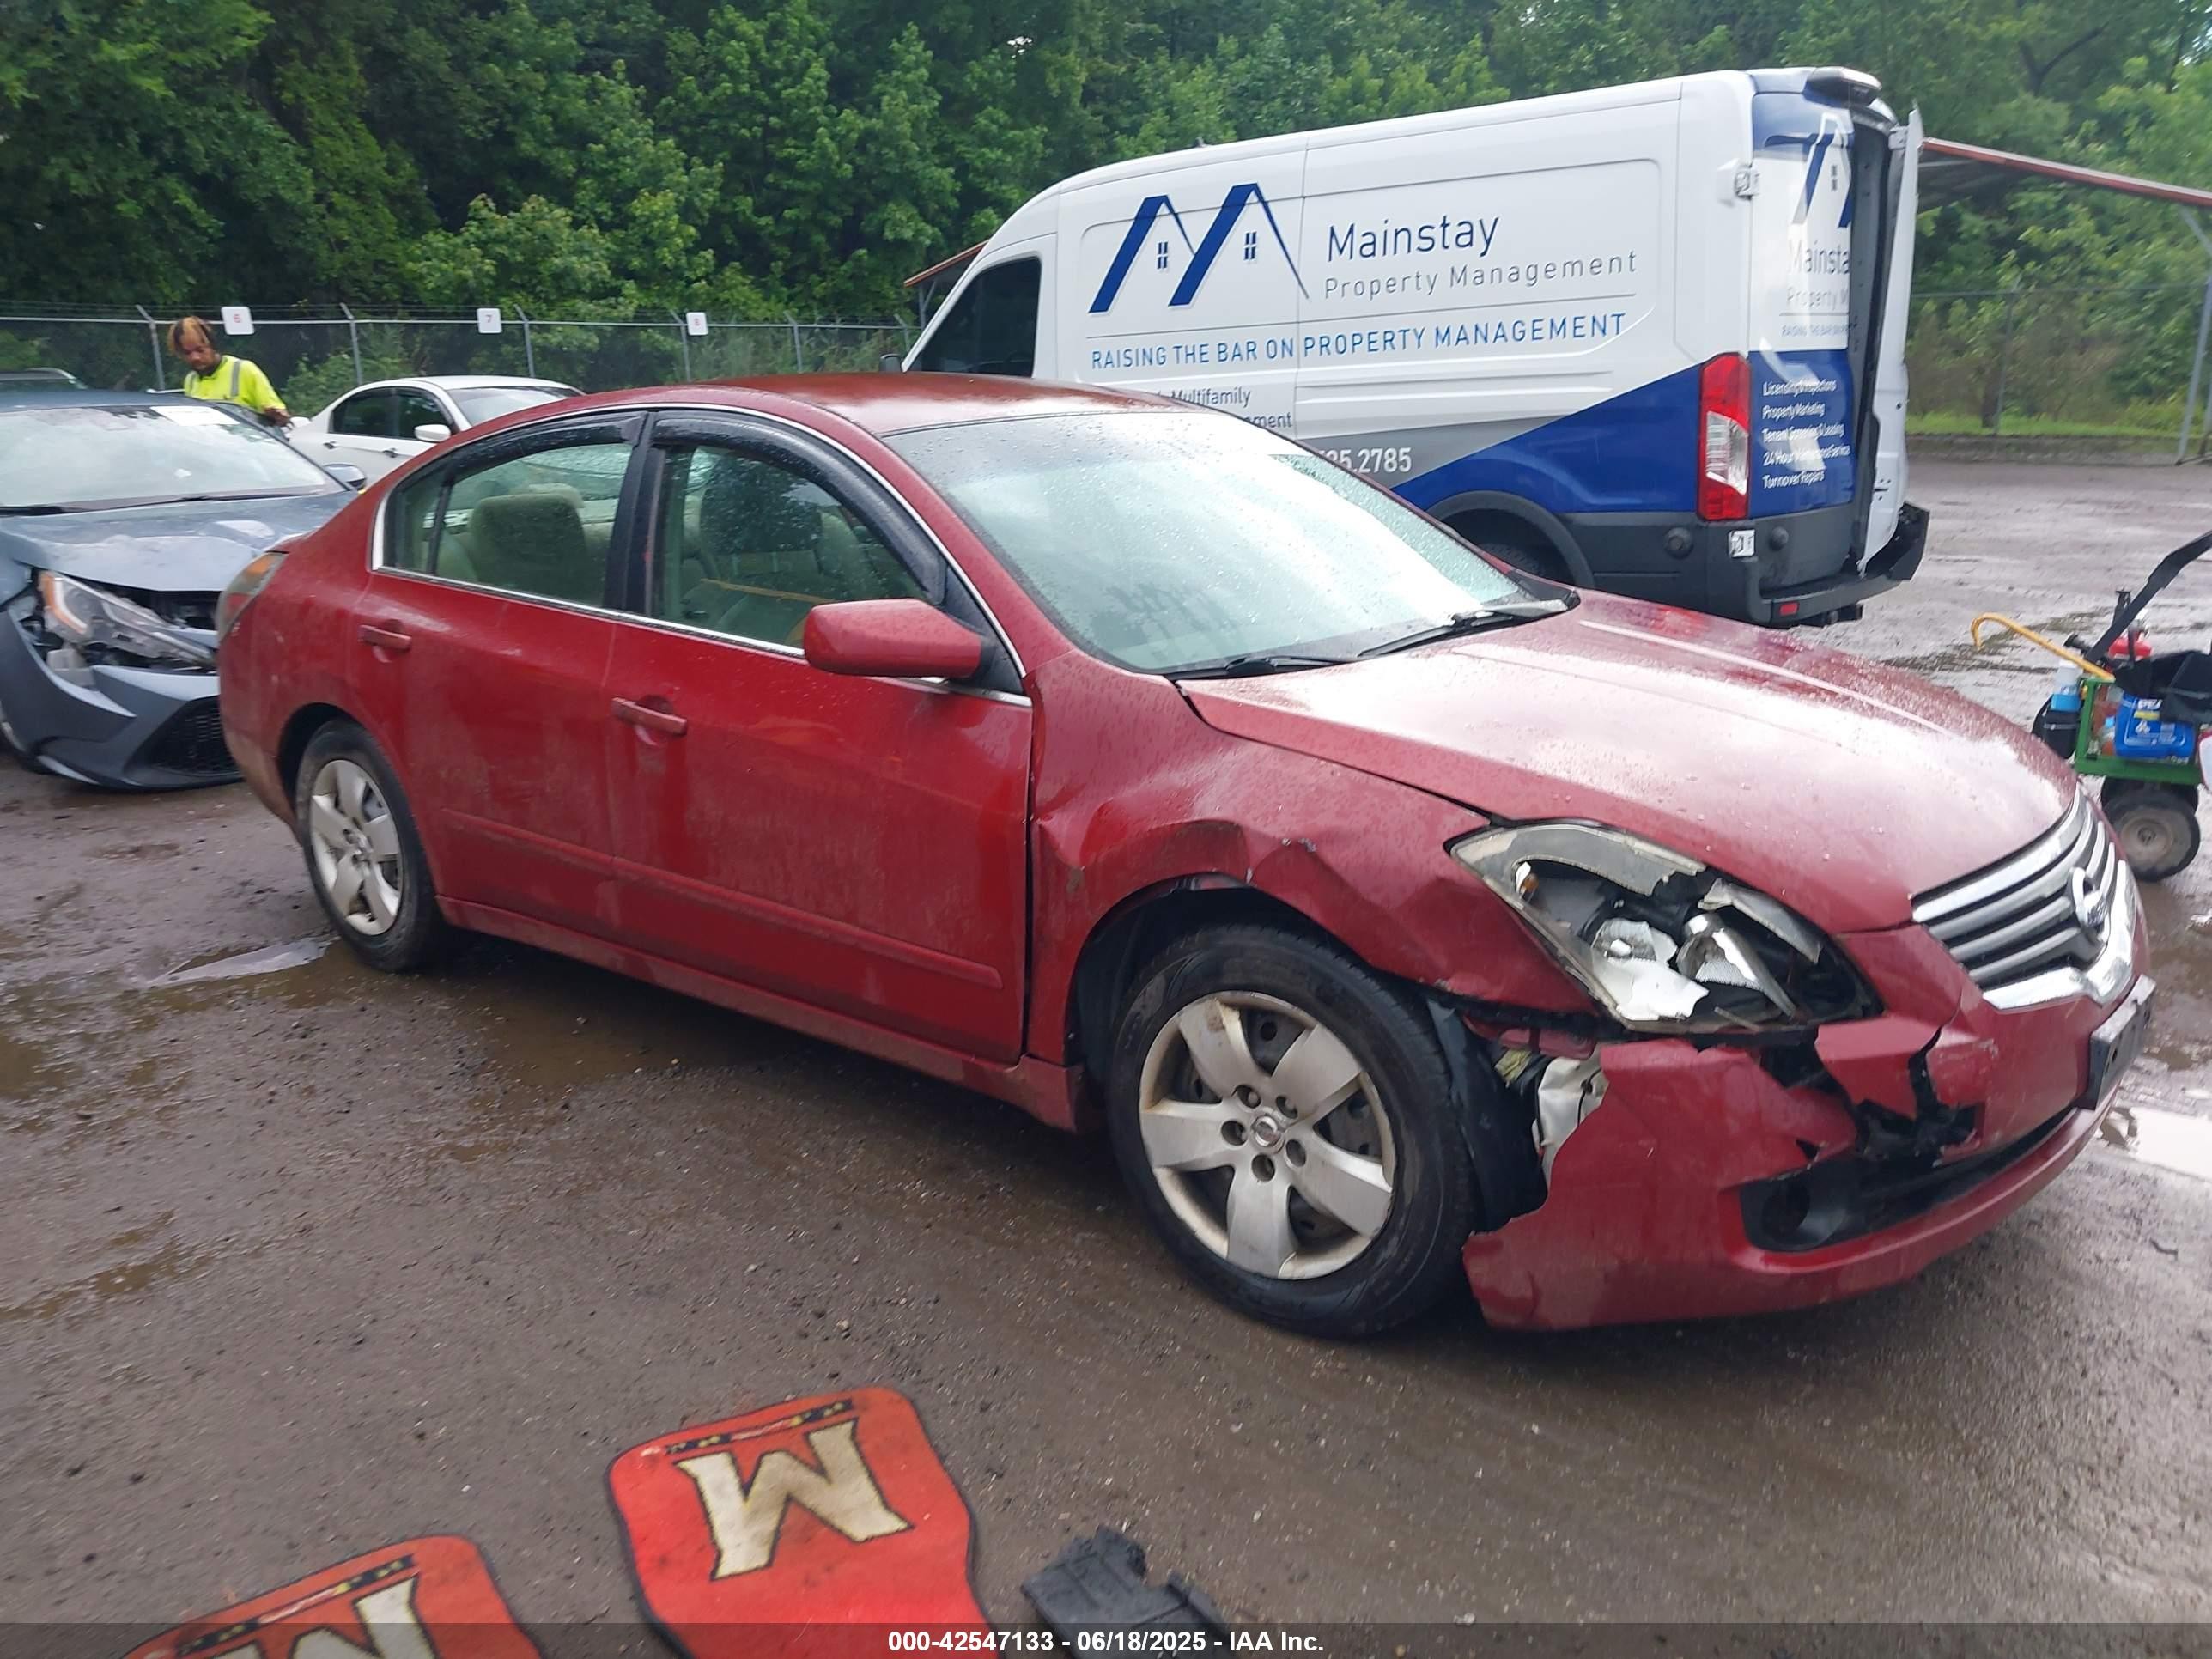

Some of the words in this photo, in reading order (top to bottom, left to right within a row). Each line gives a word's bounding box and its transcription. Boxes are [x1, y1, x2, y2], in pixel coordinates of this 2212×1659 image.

[1328, 215, 1499, 262] Mainstay
[1788, 240, 1850, 275] Mainsta
[1325, 270, 1438, 301] Property
[1449, 250, 1637, 288] Management
[1091, 346, 1166, 369] RAISING
[1173, 343, 1210, 364] THE
[1217, 340, 1258, 363] BAR
[1266, 338, 1294, 360] ON
[1304, 327, 1425, 357] PROPERTY
[1435, 313, 1626, 349] MANAGEMENT
[1170, 386, 1251, 408] Multifamily
